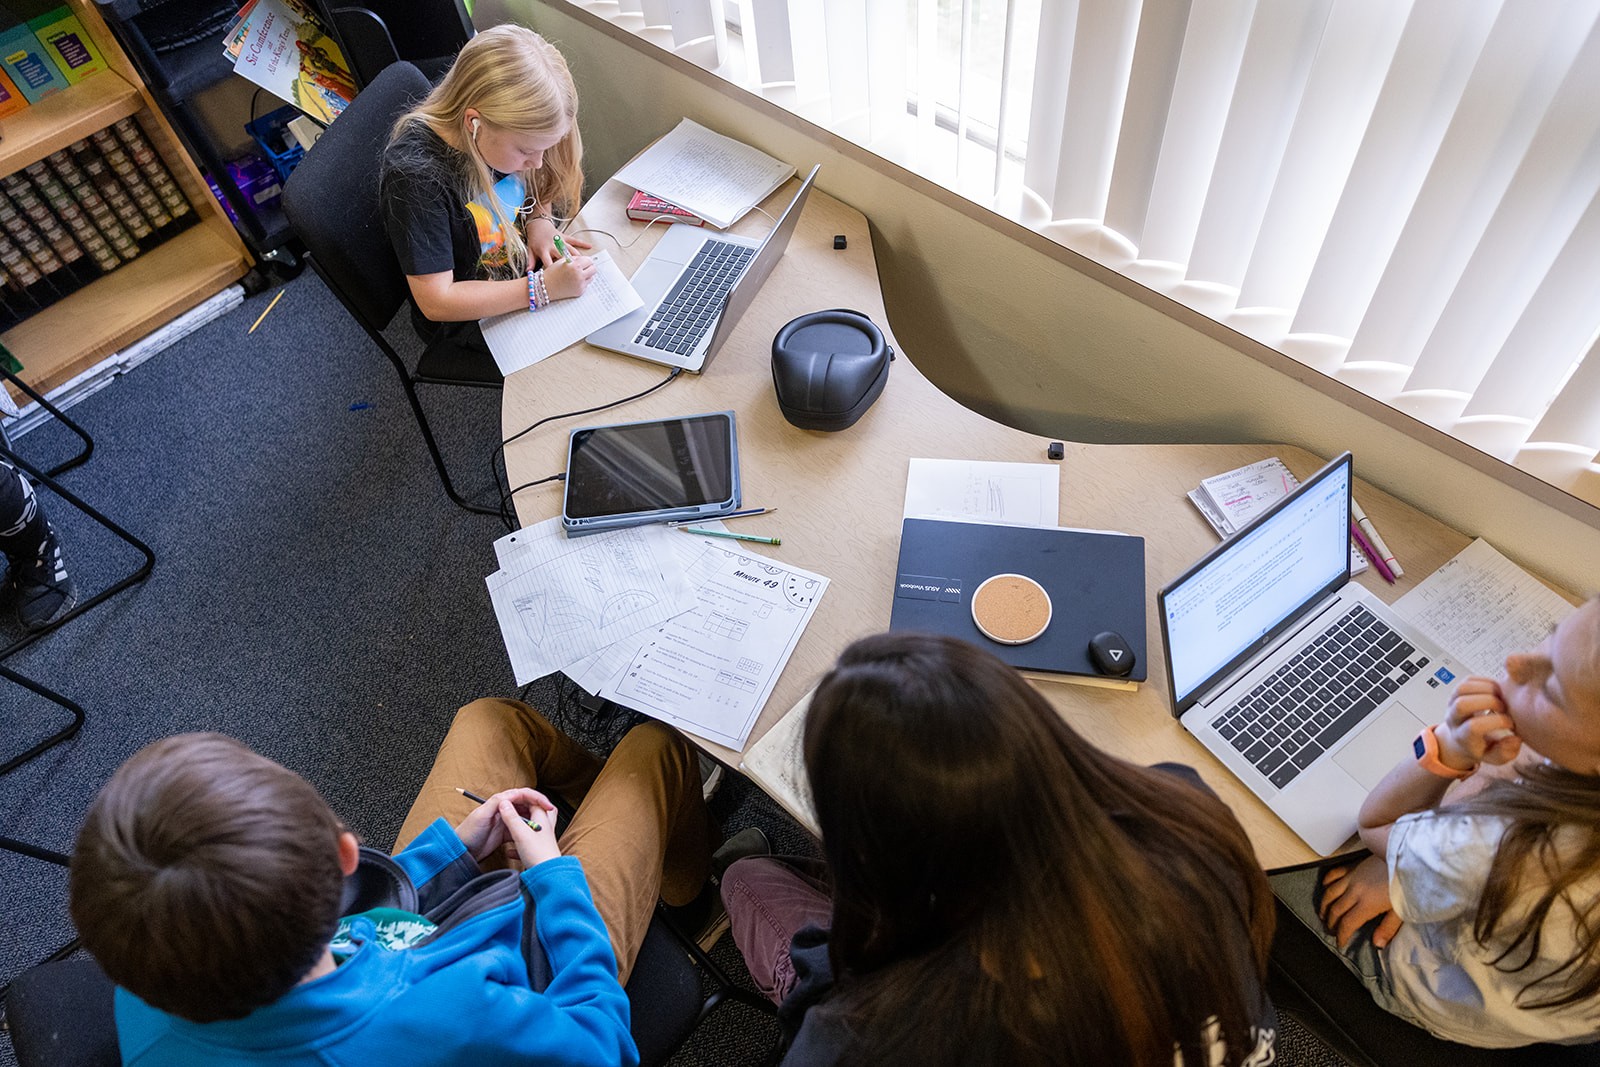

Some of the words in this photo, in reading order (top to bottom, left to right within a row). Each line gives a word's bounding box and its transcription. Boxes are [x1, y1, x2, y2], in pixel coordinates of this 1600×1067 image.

[250, 12, 275, 54] Cumference
[245, 53, 259, 66] Sir
[733, 570, 761, 583] MINUTE
[763, 580, 778, 588] 49
